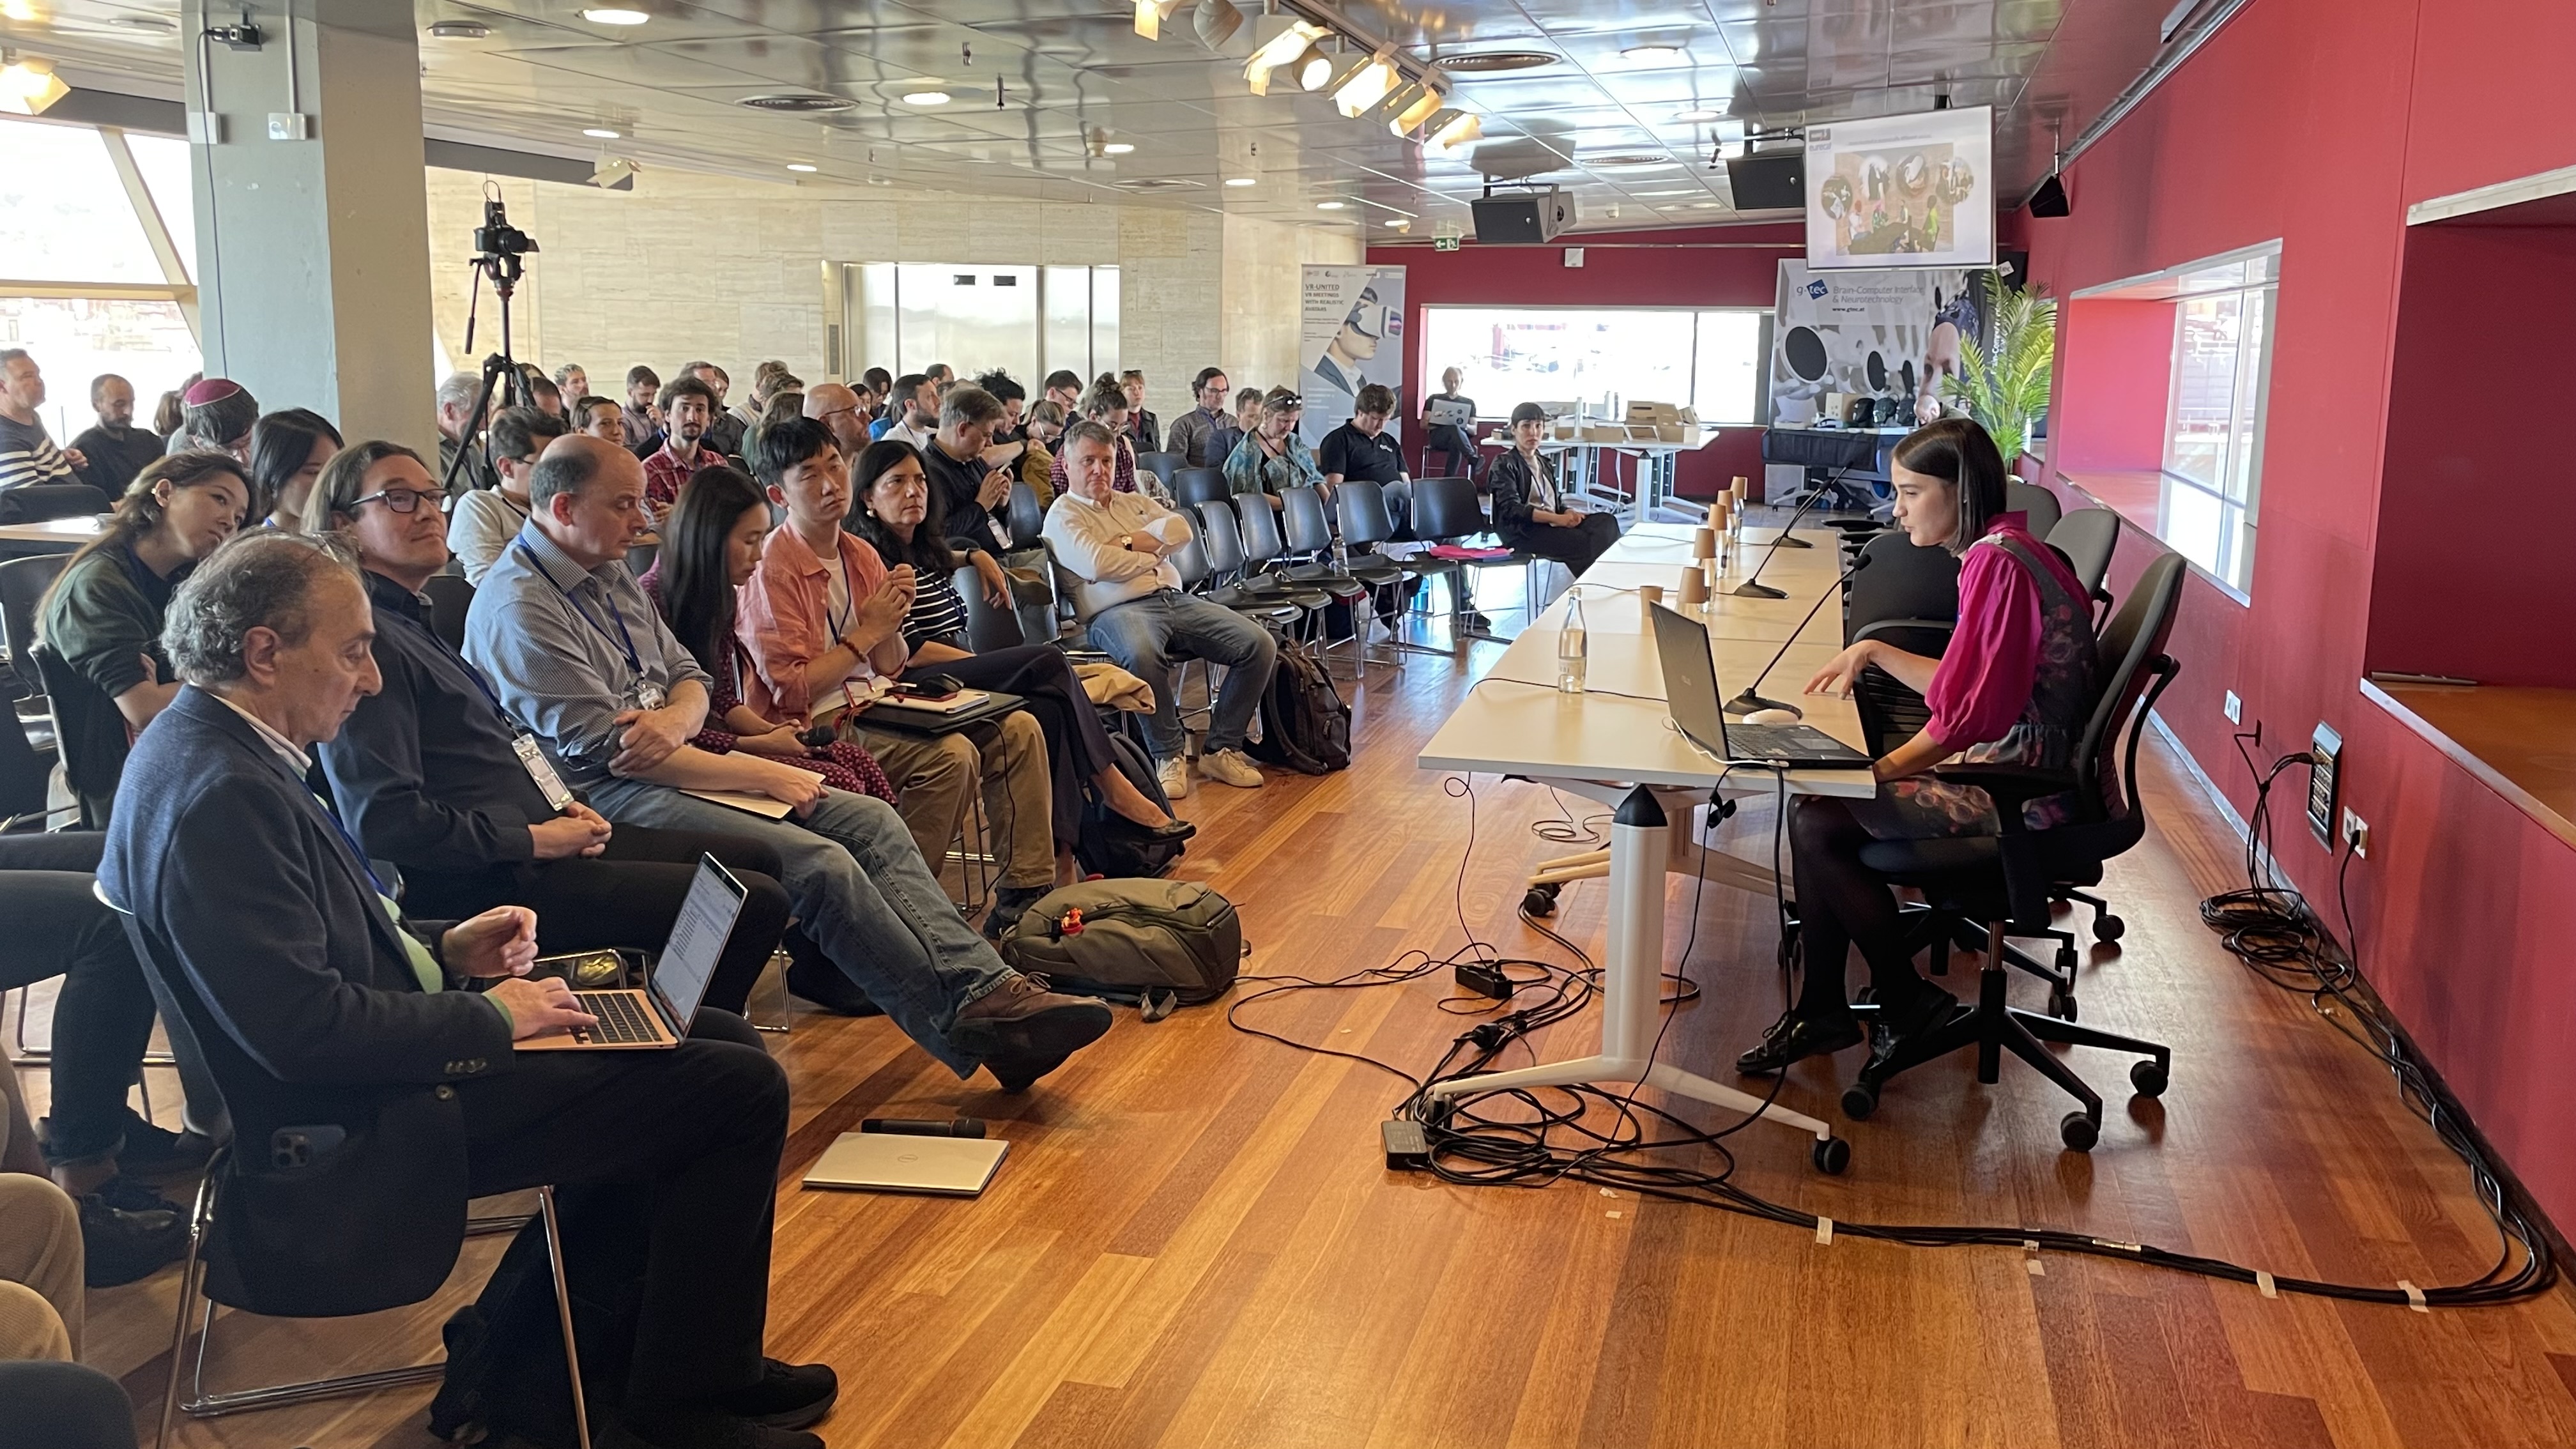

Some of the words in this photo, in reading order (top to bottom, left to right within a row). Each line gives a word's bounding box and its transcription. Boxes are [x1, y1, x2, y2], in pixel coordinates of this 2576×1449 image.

[1833, 286, 1893, 294] Brain-Computer
[1894, 285, 1924, 293] Interface
[1841, 295, 1903, 305] Neurotechnology
